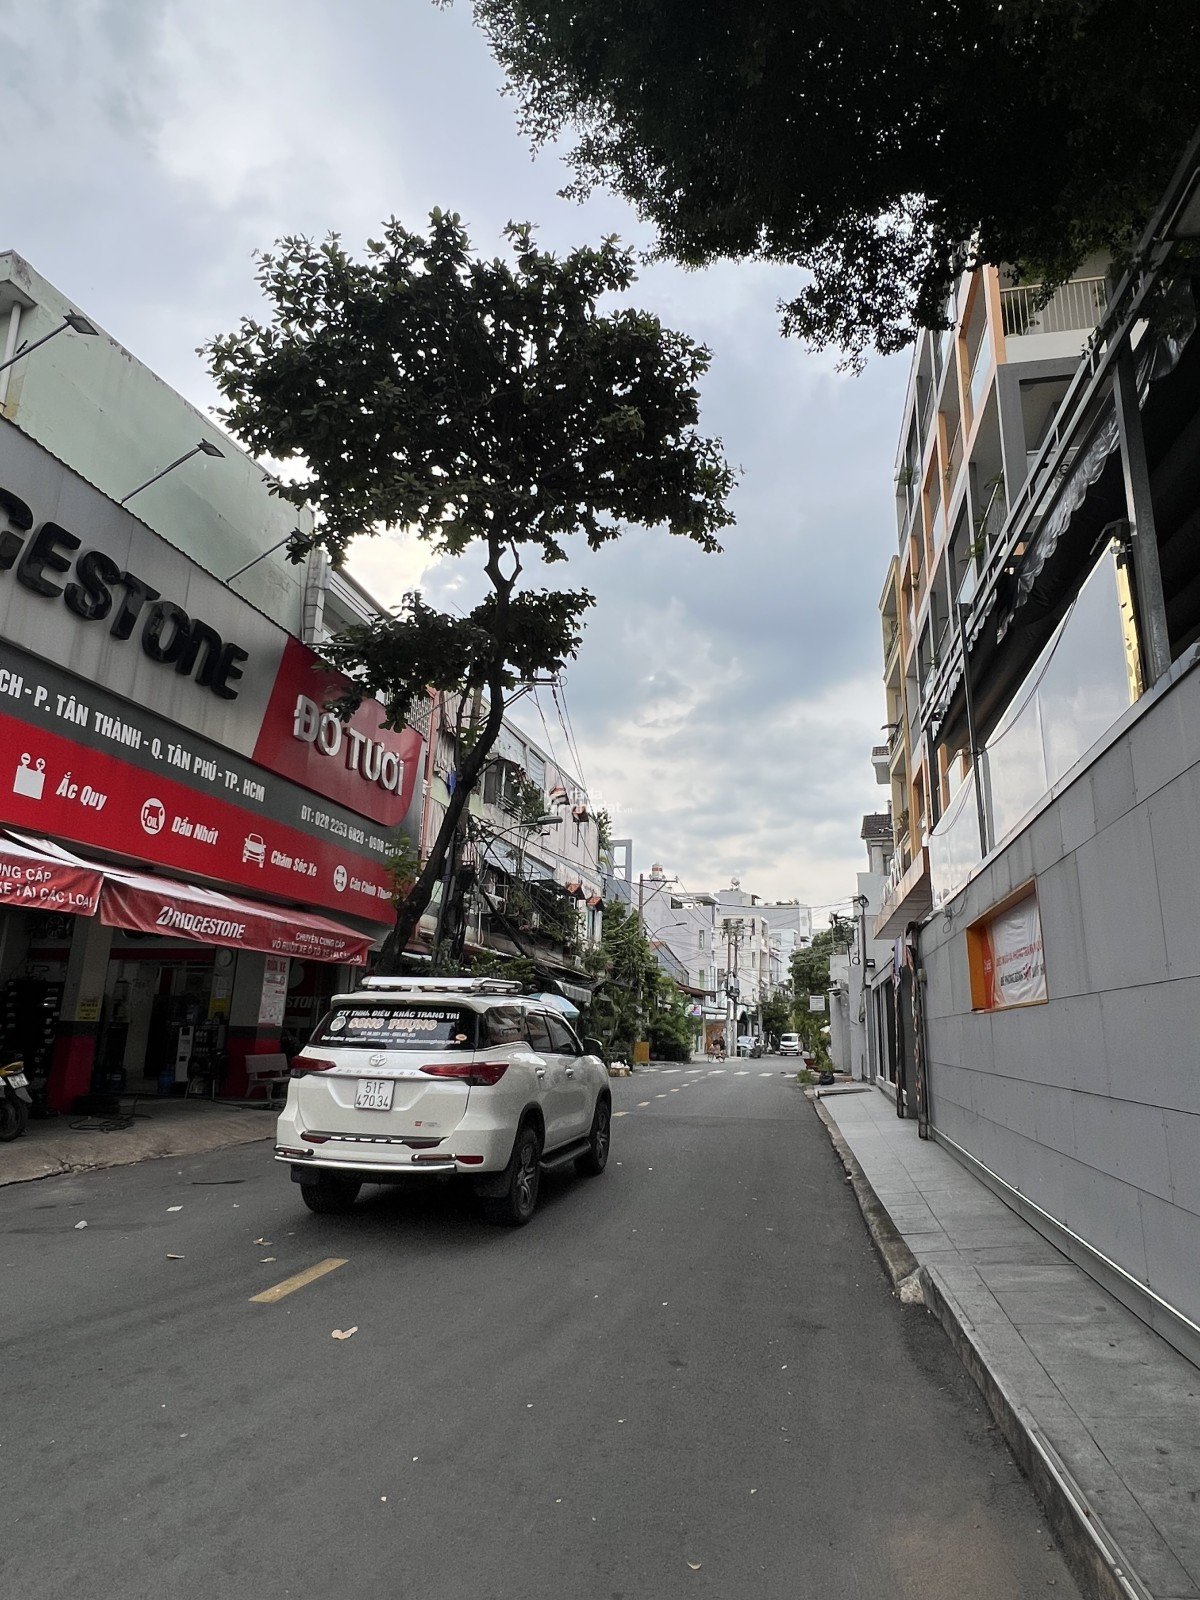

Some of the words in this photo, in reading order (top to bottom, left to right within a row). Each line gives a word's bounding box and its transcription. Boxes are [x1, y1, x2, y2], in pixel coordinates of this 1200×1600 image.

[34, 686, 50, 711] P.
[56, 695, 89, 727] TÂN
[94, 711, 142, 749] THÀNH
[151, 738, 163, 759] Q.
[167, 744, 191, 770] TÂN
[193, 760, 217, 781] PHÚ
[225, 770, 239, 792] TP.
[242, 779, 265, 802] HCM
[80, 785, 107, 811] Quy
[147, 816, 158, 829] OIL
[315, 811, 330, 829] 028
[329, 818, 347, 838] 2253
[25, 866, 52, 883] CẤP
[293, 858, 308, 874] Sóc
[307, 863, 317, 877] Xe
[40, 886, 65, 903] CÁC
[69, 893, 92, 909] LOẠI
[156, 906, 246, 939] BRIDGESTONE
[348, 1018, 384, 1030] SONG
[417, 1011, 445, 1019] TRANG
[365, 1081, 385, 1094] 51F
